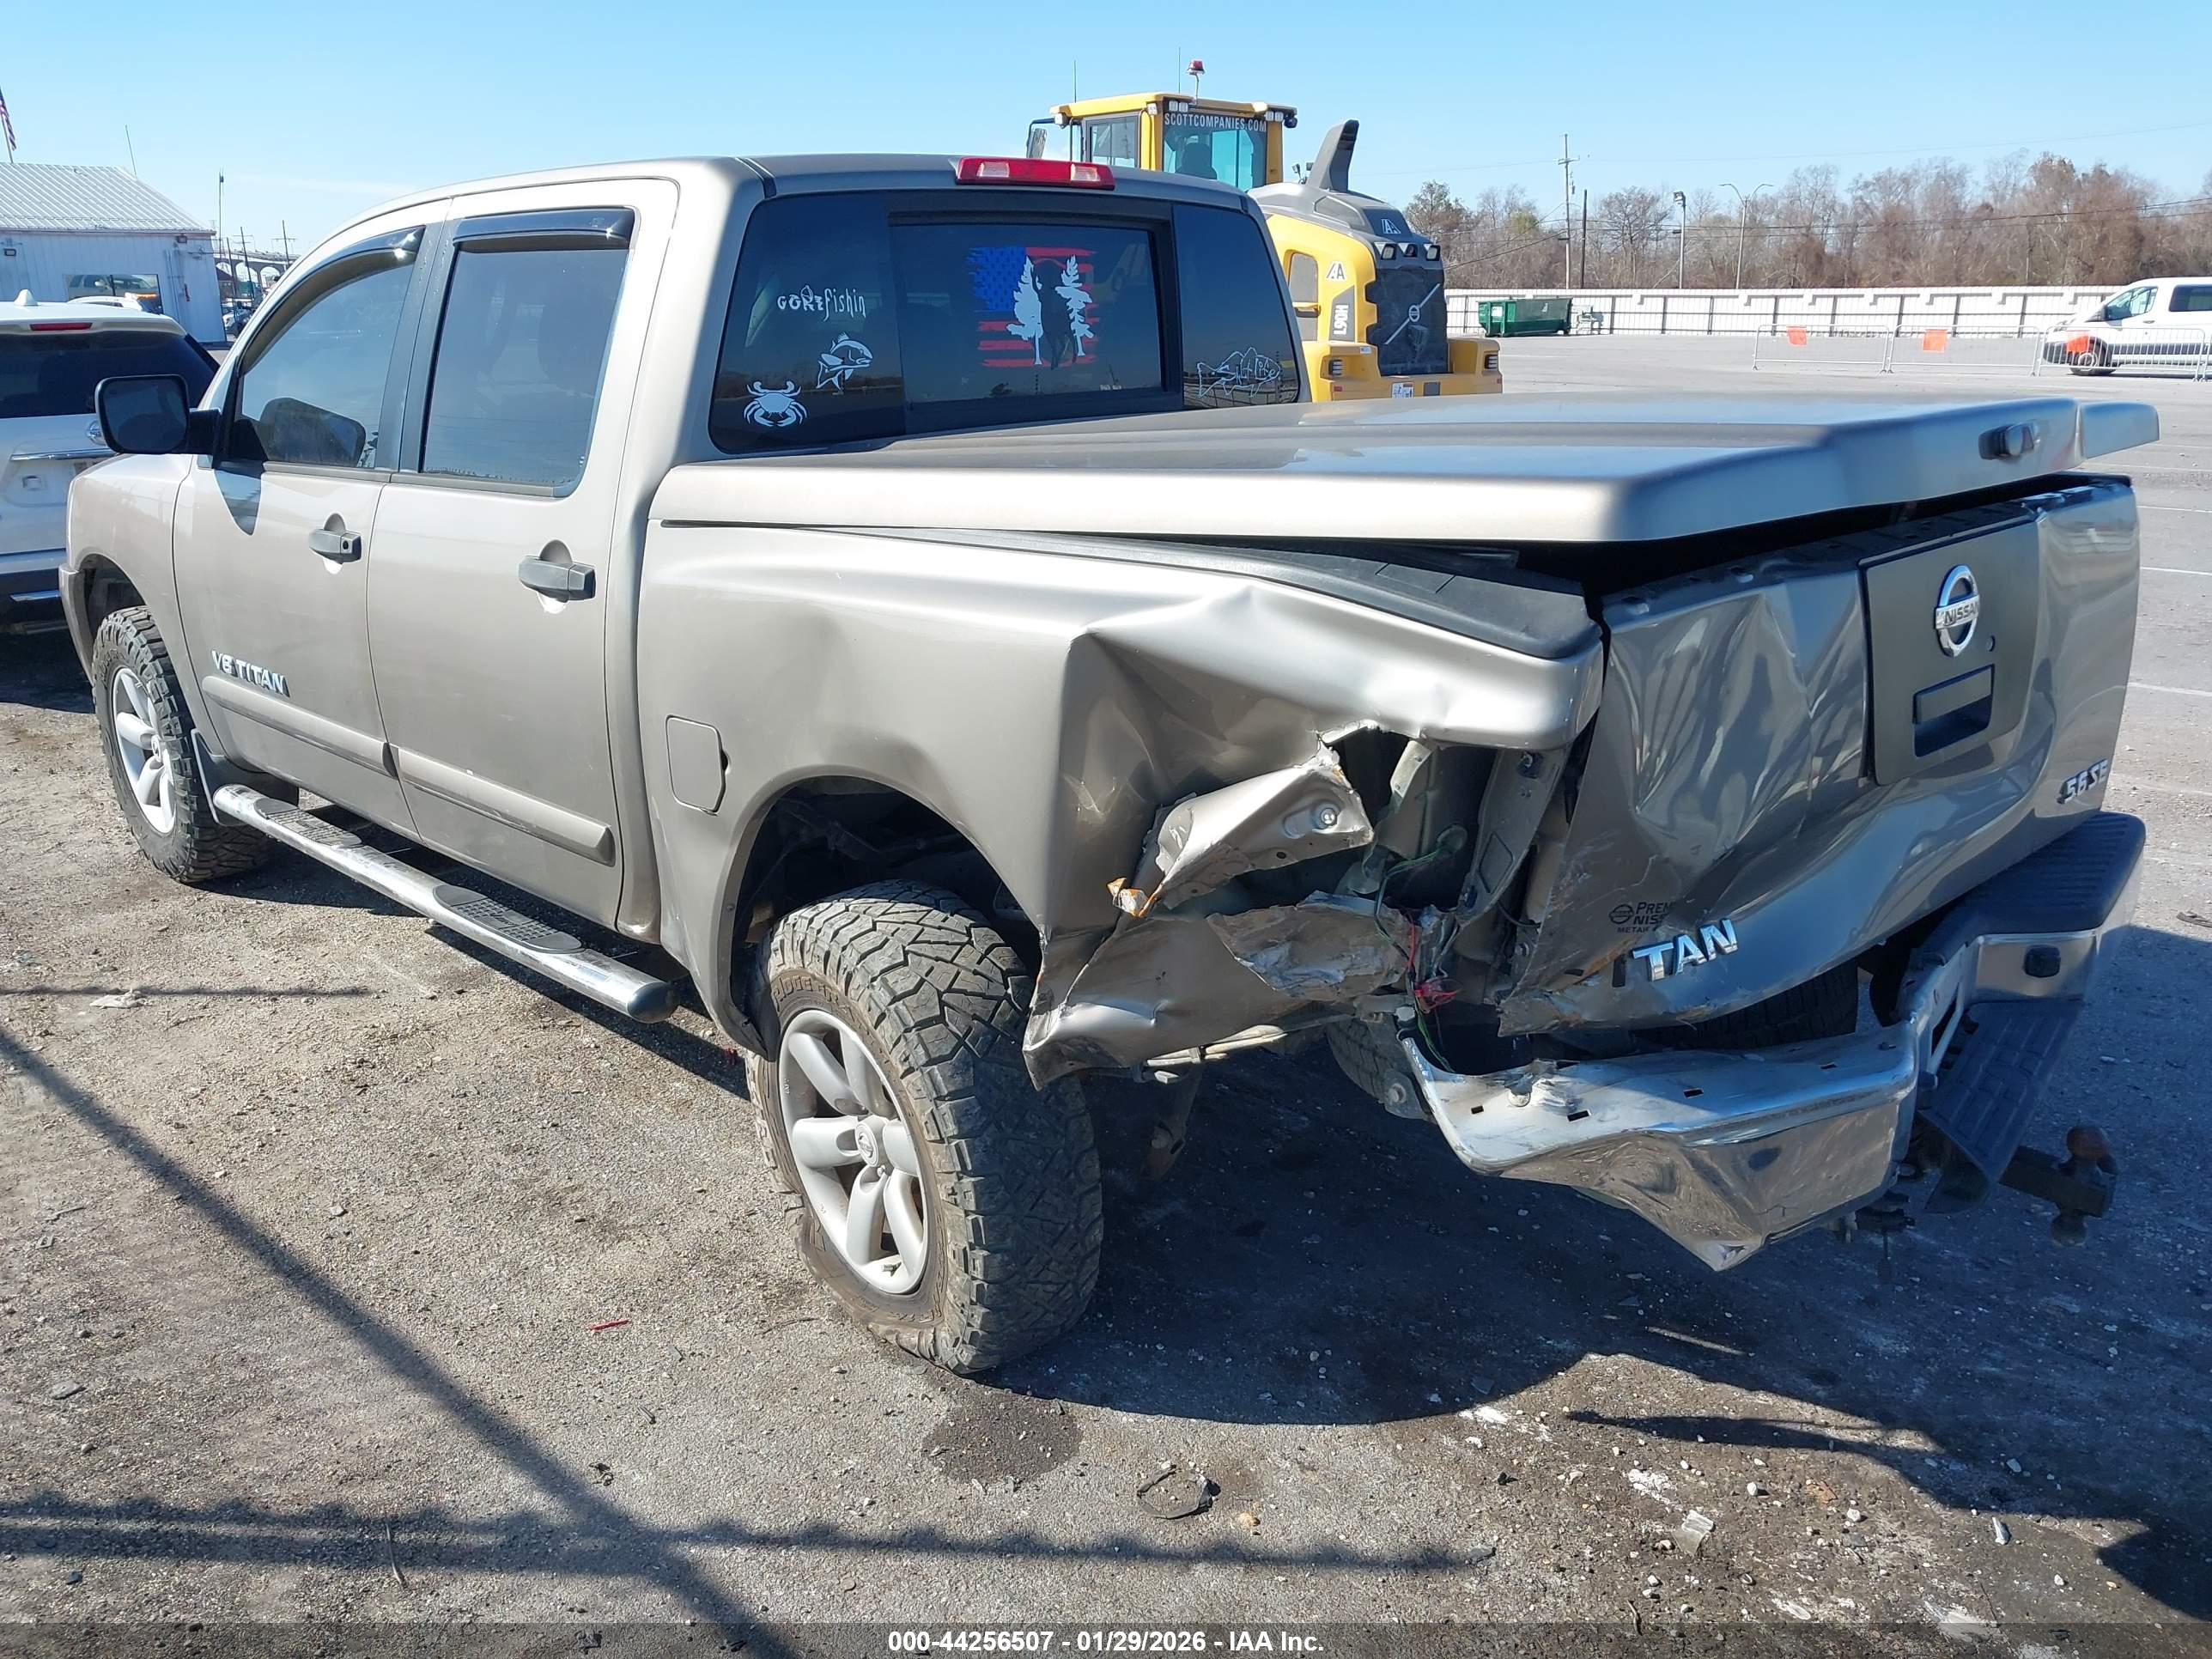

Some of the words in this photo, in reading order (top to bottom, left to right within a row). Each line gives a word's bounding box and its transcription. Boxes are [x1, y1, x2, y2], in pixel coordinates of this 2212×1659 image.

[1164, 112, 1267, 131] SCOTTCOMPANIES.COM
[1333, 304, 1349, 335] L90H
[235, 659, 289, 697] TITAN
